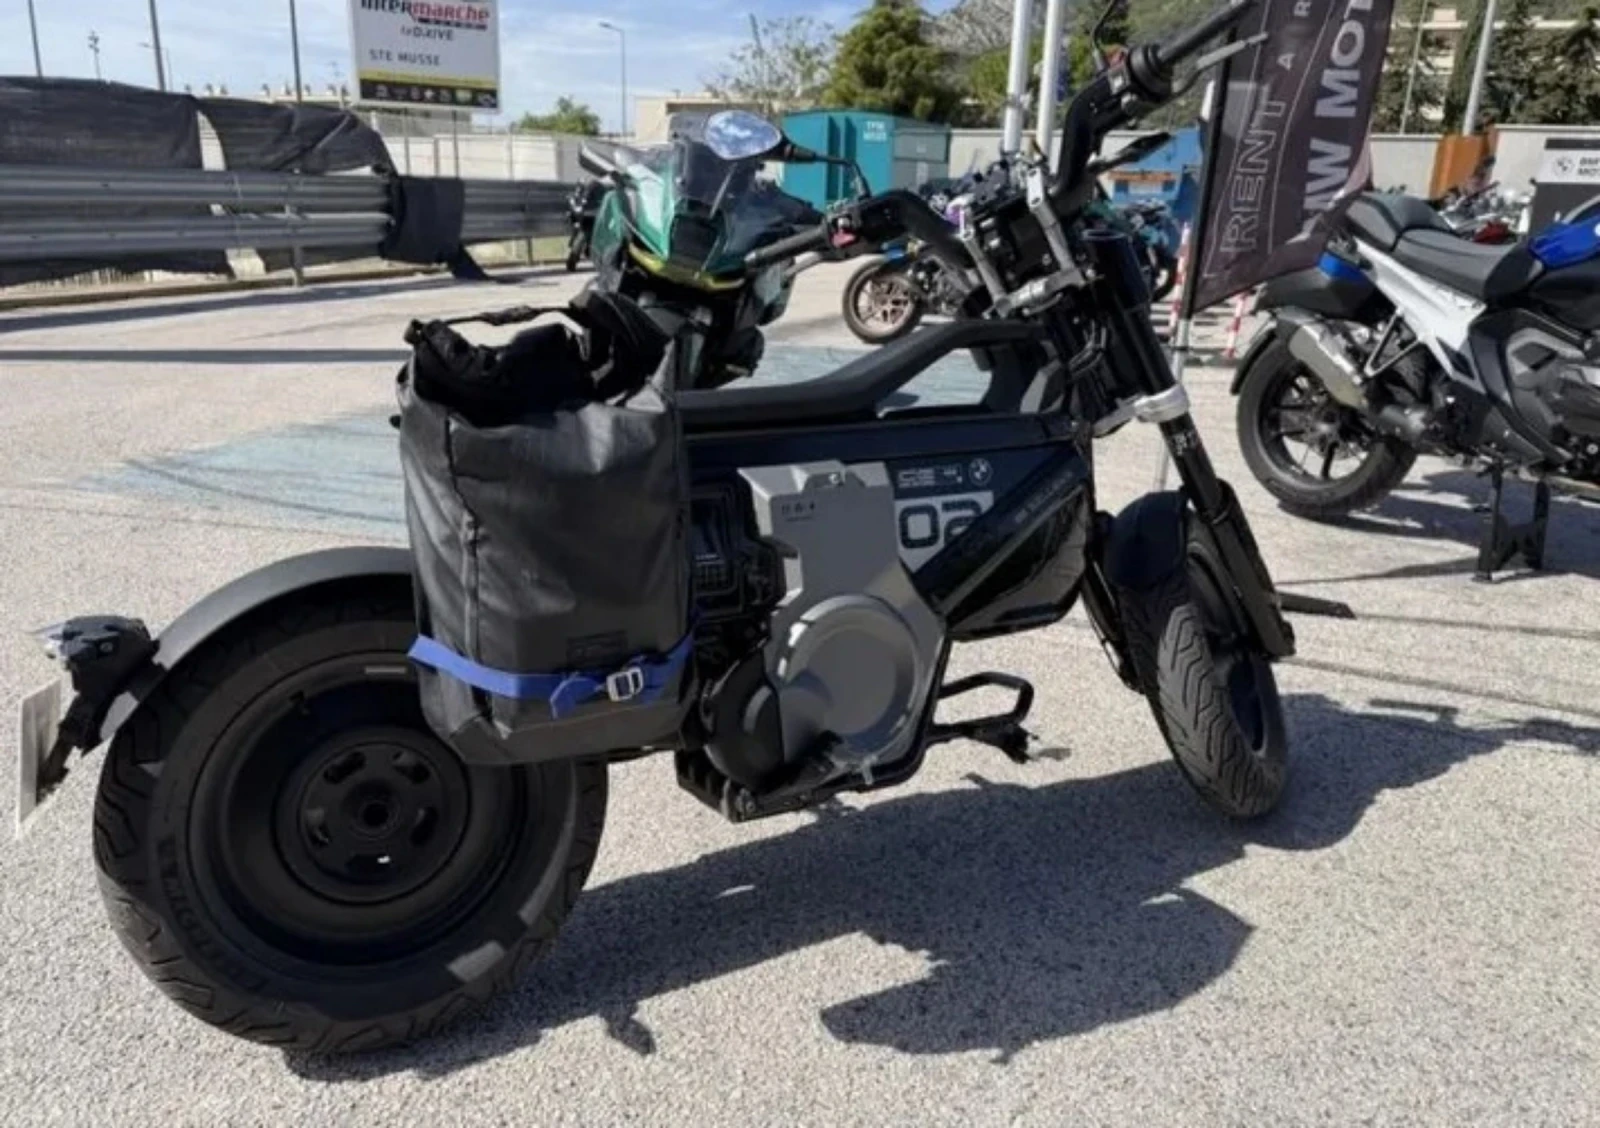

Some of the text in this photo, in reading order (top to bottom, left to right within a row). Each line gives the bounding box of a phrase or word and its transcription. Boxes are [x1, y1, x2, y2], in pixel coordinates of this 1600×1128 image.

[369, 49, 441, 66] STE MUSSE
[1217, 84, 1287, 252] RENT
[1276, 53, 1295, 71] A
